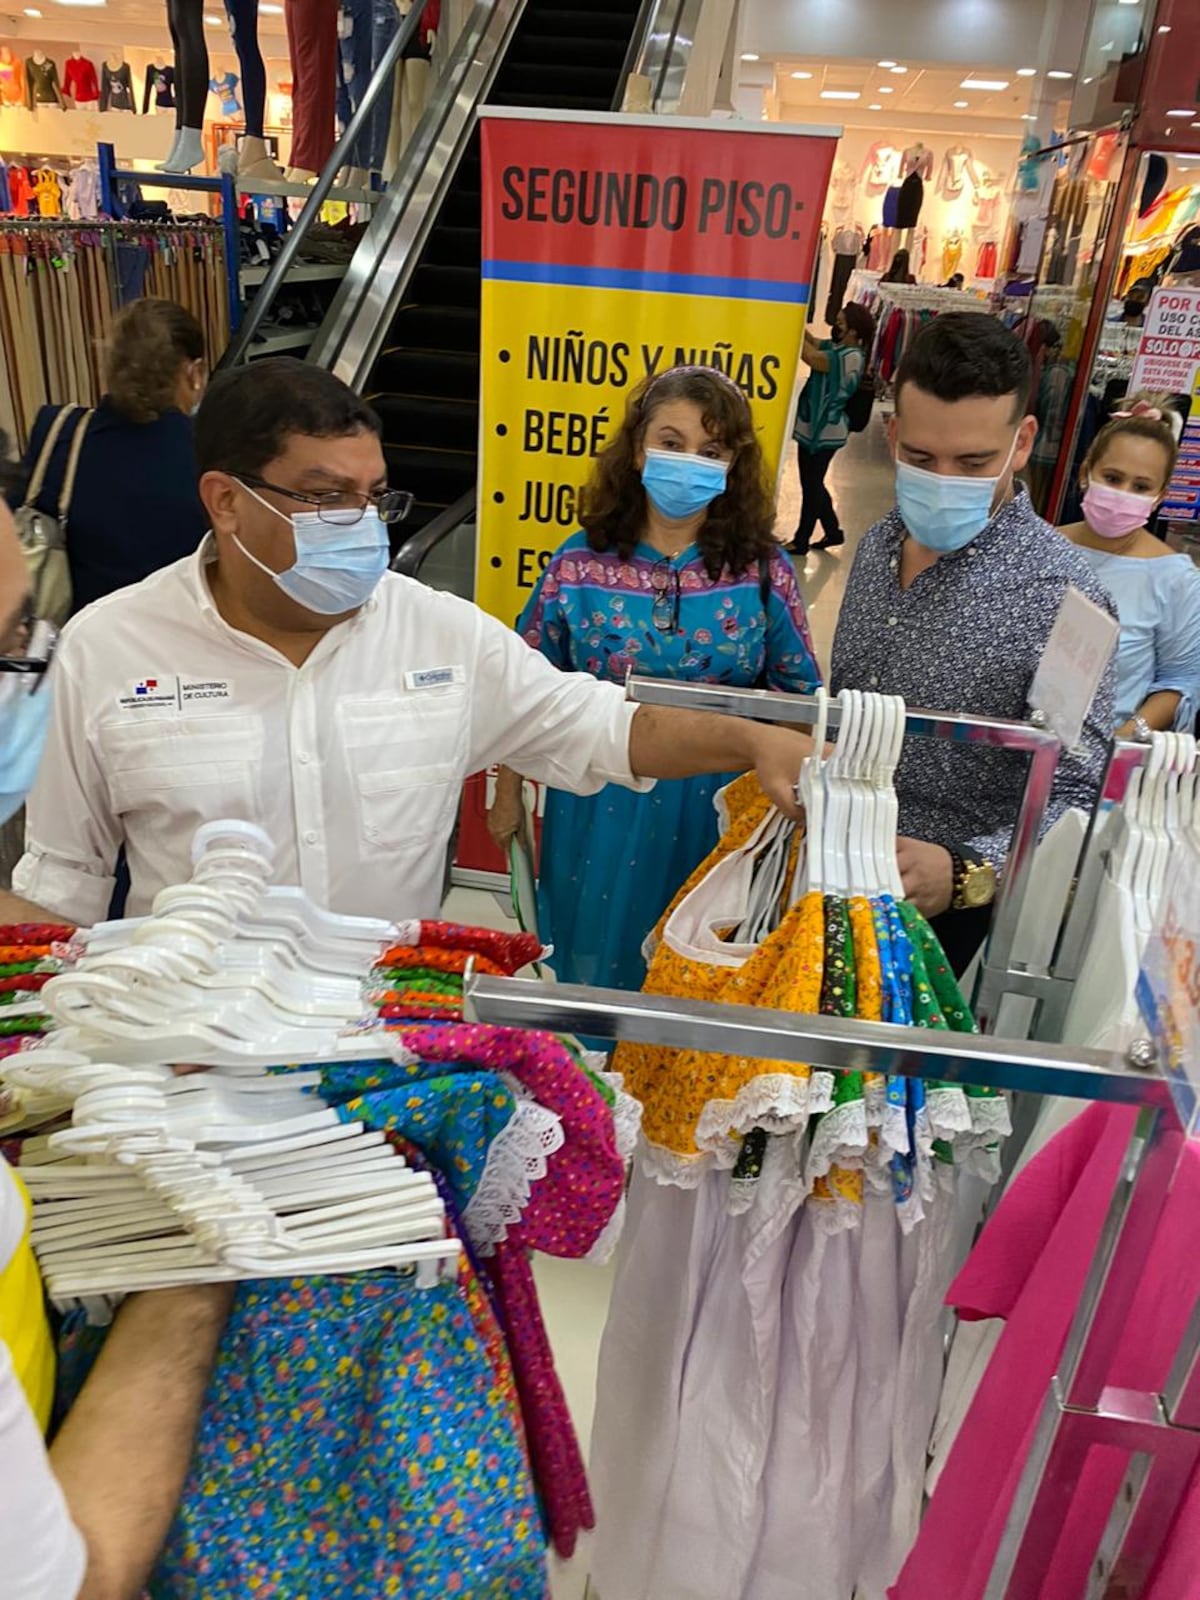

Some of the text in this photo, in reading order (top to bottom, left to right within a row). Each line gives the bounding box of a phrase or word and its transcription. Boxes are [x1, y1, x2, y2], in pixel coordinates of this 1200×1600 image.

[501, 165, 805, 241] SEGUNDO PISO:
[1159, 296, 1191, 310] POR
[1160, 312, 1186, 324] USO
[1158, 325, 1182, 336] DEL
[1145, 339, 1179, 355] SOLO
[527, 330, 629, 388] NIÑOS
[641, 344, 664, 377] Y
[518, 481, 586, 526] JUG
[183, 682, 227, 691] MINISTERIO
[194, 691, 228, 699] CULTURA
